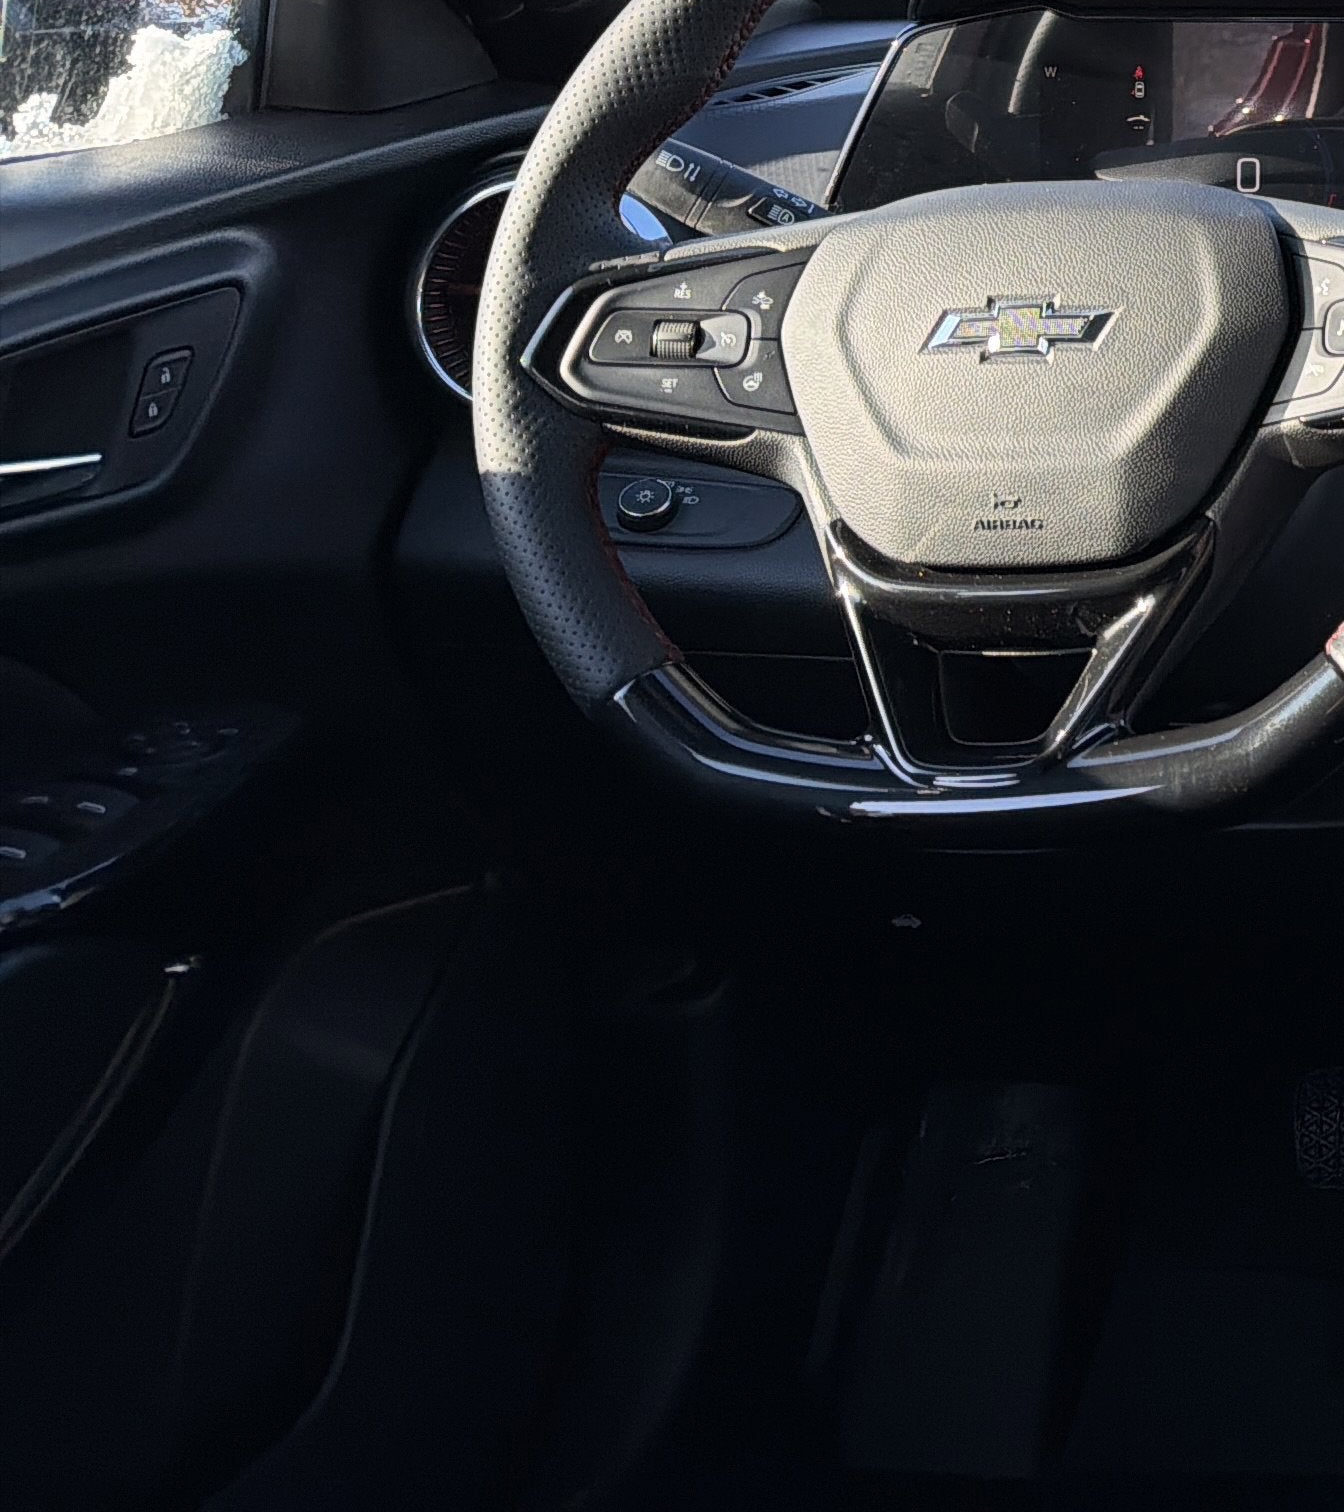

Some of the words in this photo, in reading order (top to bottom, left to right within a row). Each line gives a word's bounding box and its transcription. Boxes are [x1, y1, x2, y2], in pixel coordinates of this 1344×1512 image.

[1044, 66, 1057, 78] W
[674, 289, 691, 299] RES
[661, 379, 678, 388] SET
